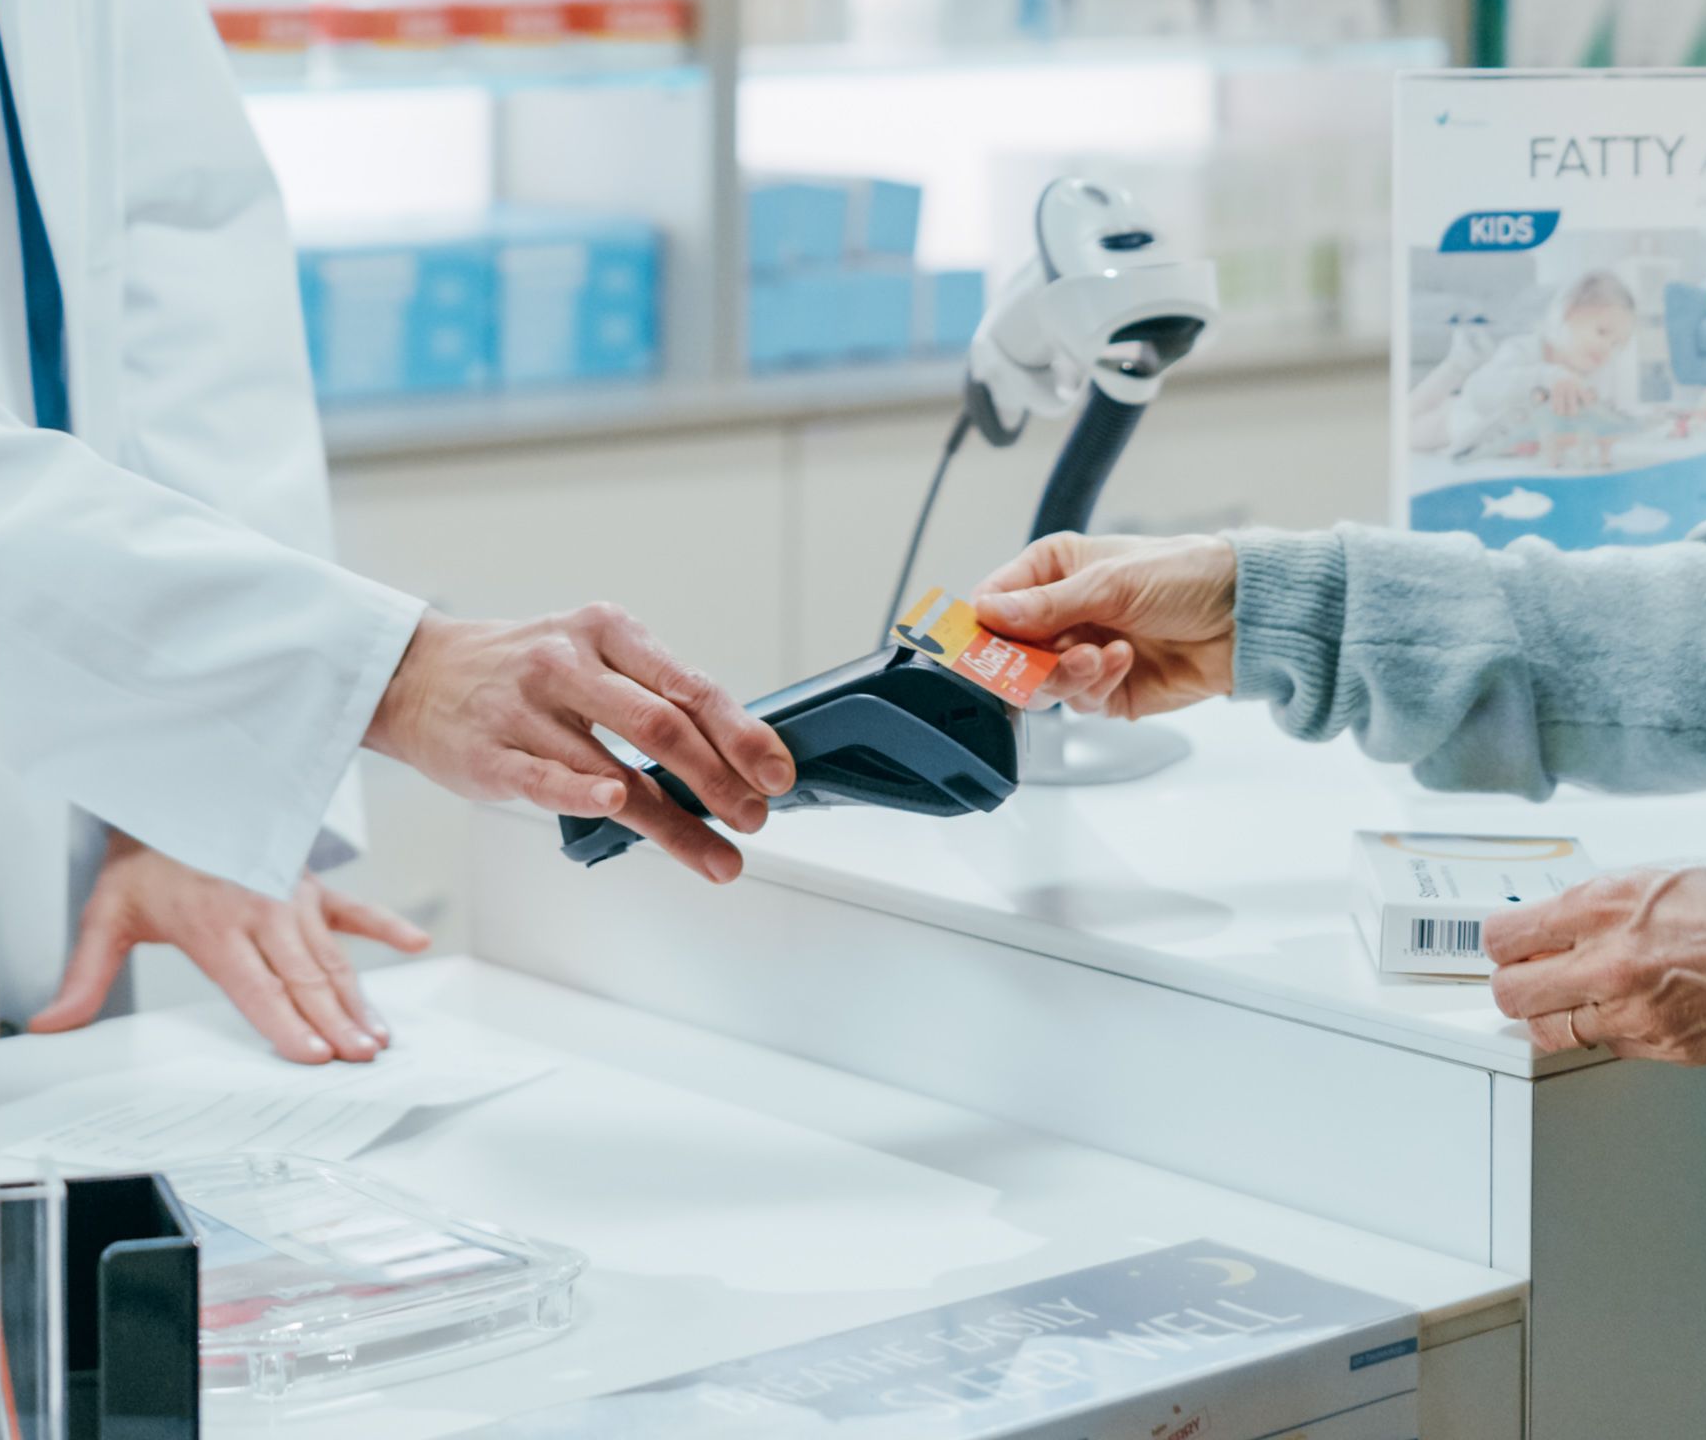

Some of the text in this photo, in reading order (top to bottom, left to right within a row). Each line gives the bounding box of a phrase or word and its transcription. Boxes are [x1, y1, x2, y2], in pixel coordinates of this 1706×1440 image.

[1528, 134, 1686, 179] FATTY
[1469, 214, 1536, 245] KIDS
[695, 1296, 1100, 1416] BREATHE EASILY
[878, 1298, 1304, 1419] SLEEP WELL
